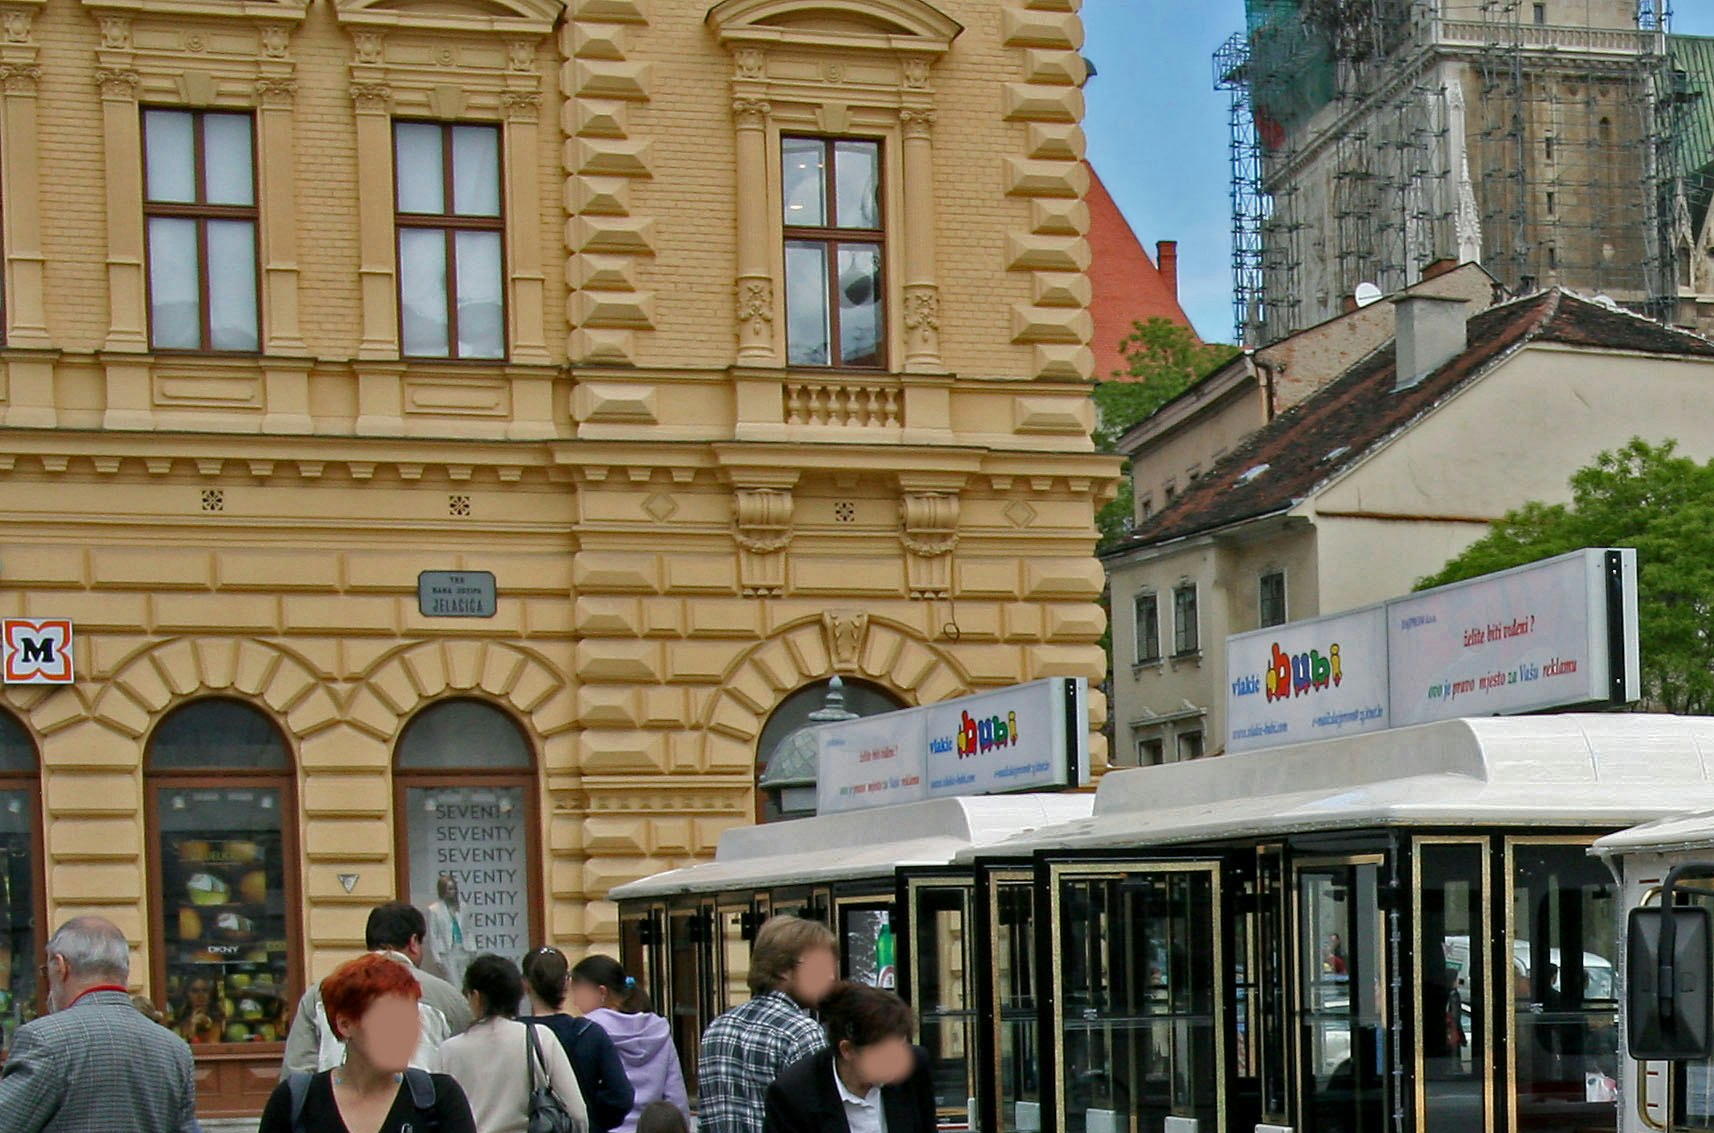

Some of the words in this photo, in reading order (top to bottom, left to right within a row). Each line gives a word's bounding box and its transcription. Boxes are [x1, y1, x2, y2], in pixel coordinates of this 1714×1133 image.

[21, 637, 55, 663] M
[1266, 642, 1342, 704] bubi
[957, 710, 1018, 759] bubi
[437, 826, 517, 841] SEVENTY
[438, 848, 516, 863] SEVENTY
